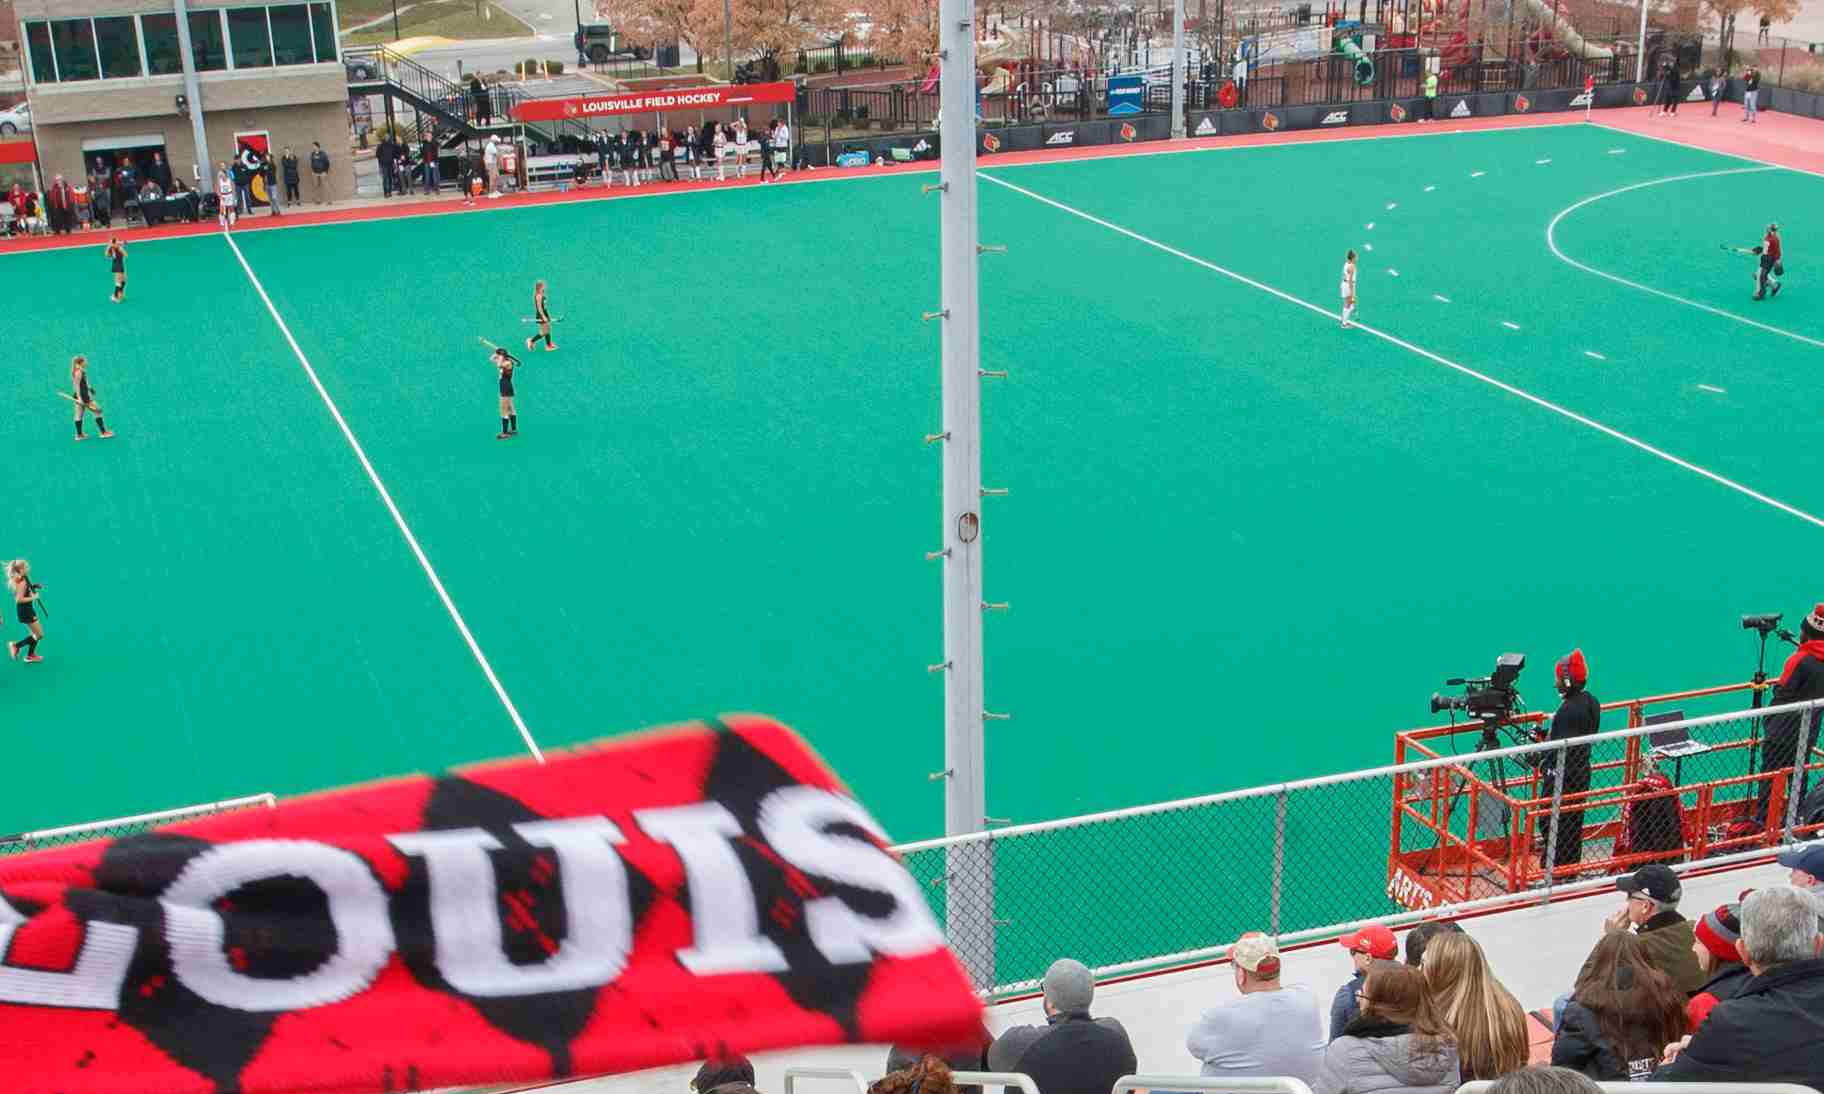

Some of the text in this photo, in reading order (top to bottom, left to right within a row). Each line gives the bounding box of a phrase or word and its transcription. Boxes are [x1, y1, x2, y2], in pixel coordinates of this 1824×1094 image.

[583, 92, 721, 113] LOUISVILLE FIELD HOCKEY
[1045, 131, 1074, 145] ACC
